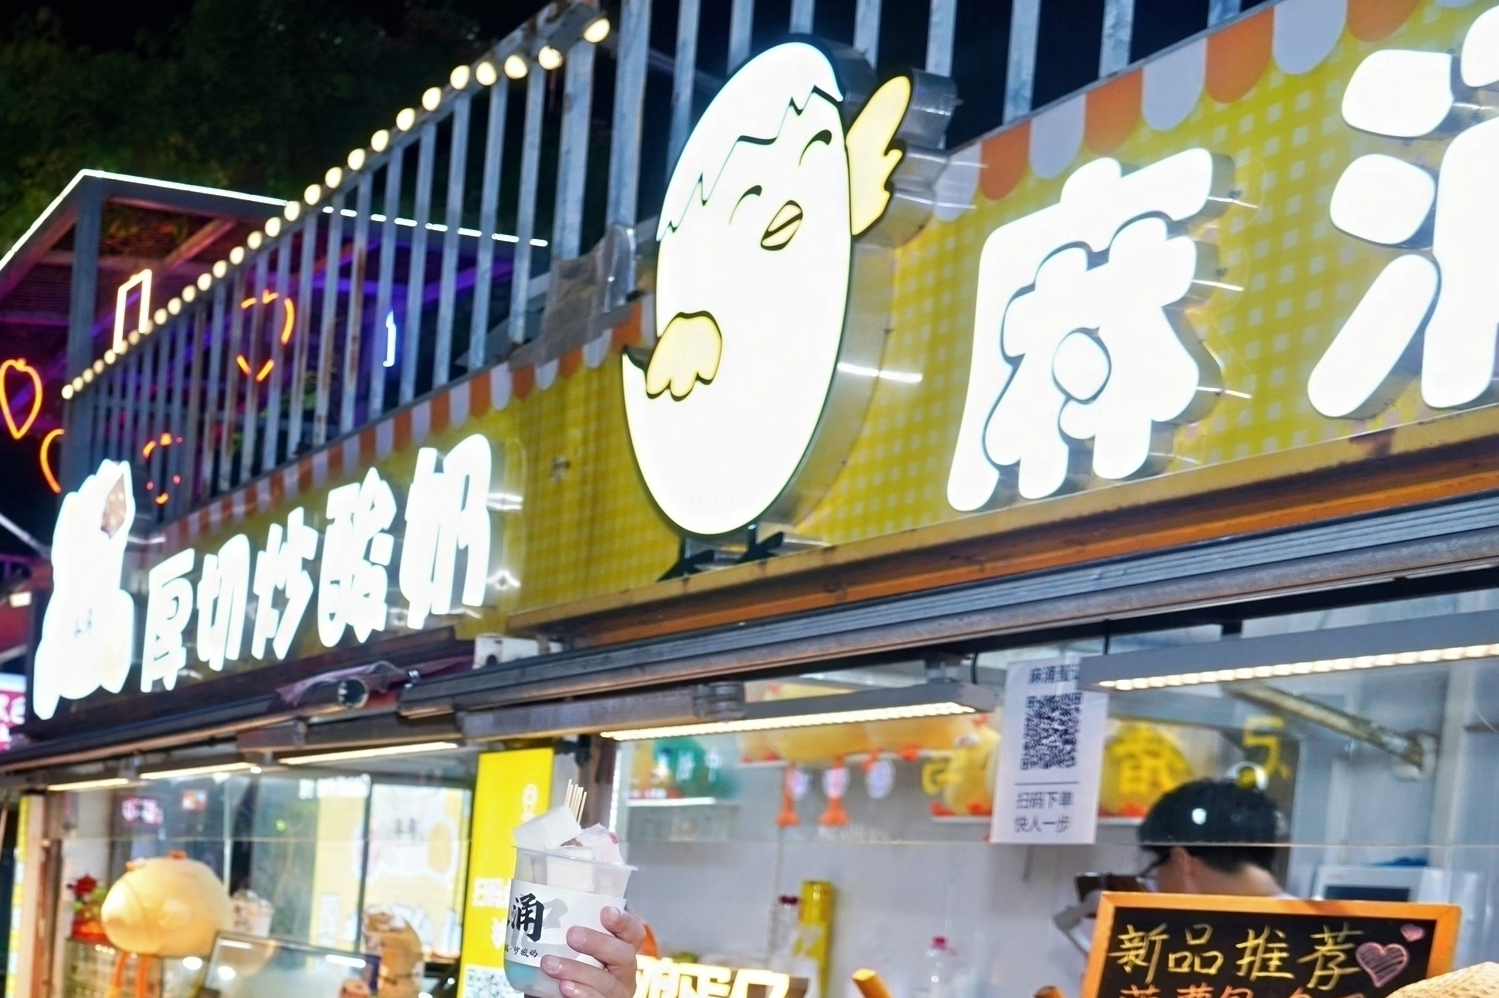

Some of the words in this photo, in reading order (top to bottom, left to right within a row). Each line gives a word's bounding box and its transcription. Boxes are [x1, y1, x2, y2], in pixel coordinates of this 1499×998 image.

[140, 433, 493, 694] 厚切炒酸奶
[1013, 815, 1072, 834] 快人一步
[1015, 791, 1074, 810] 扫码下单
[506, 892, 545, 943] 涌
[1108, 921, 1365, 991] 新品推荐
